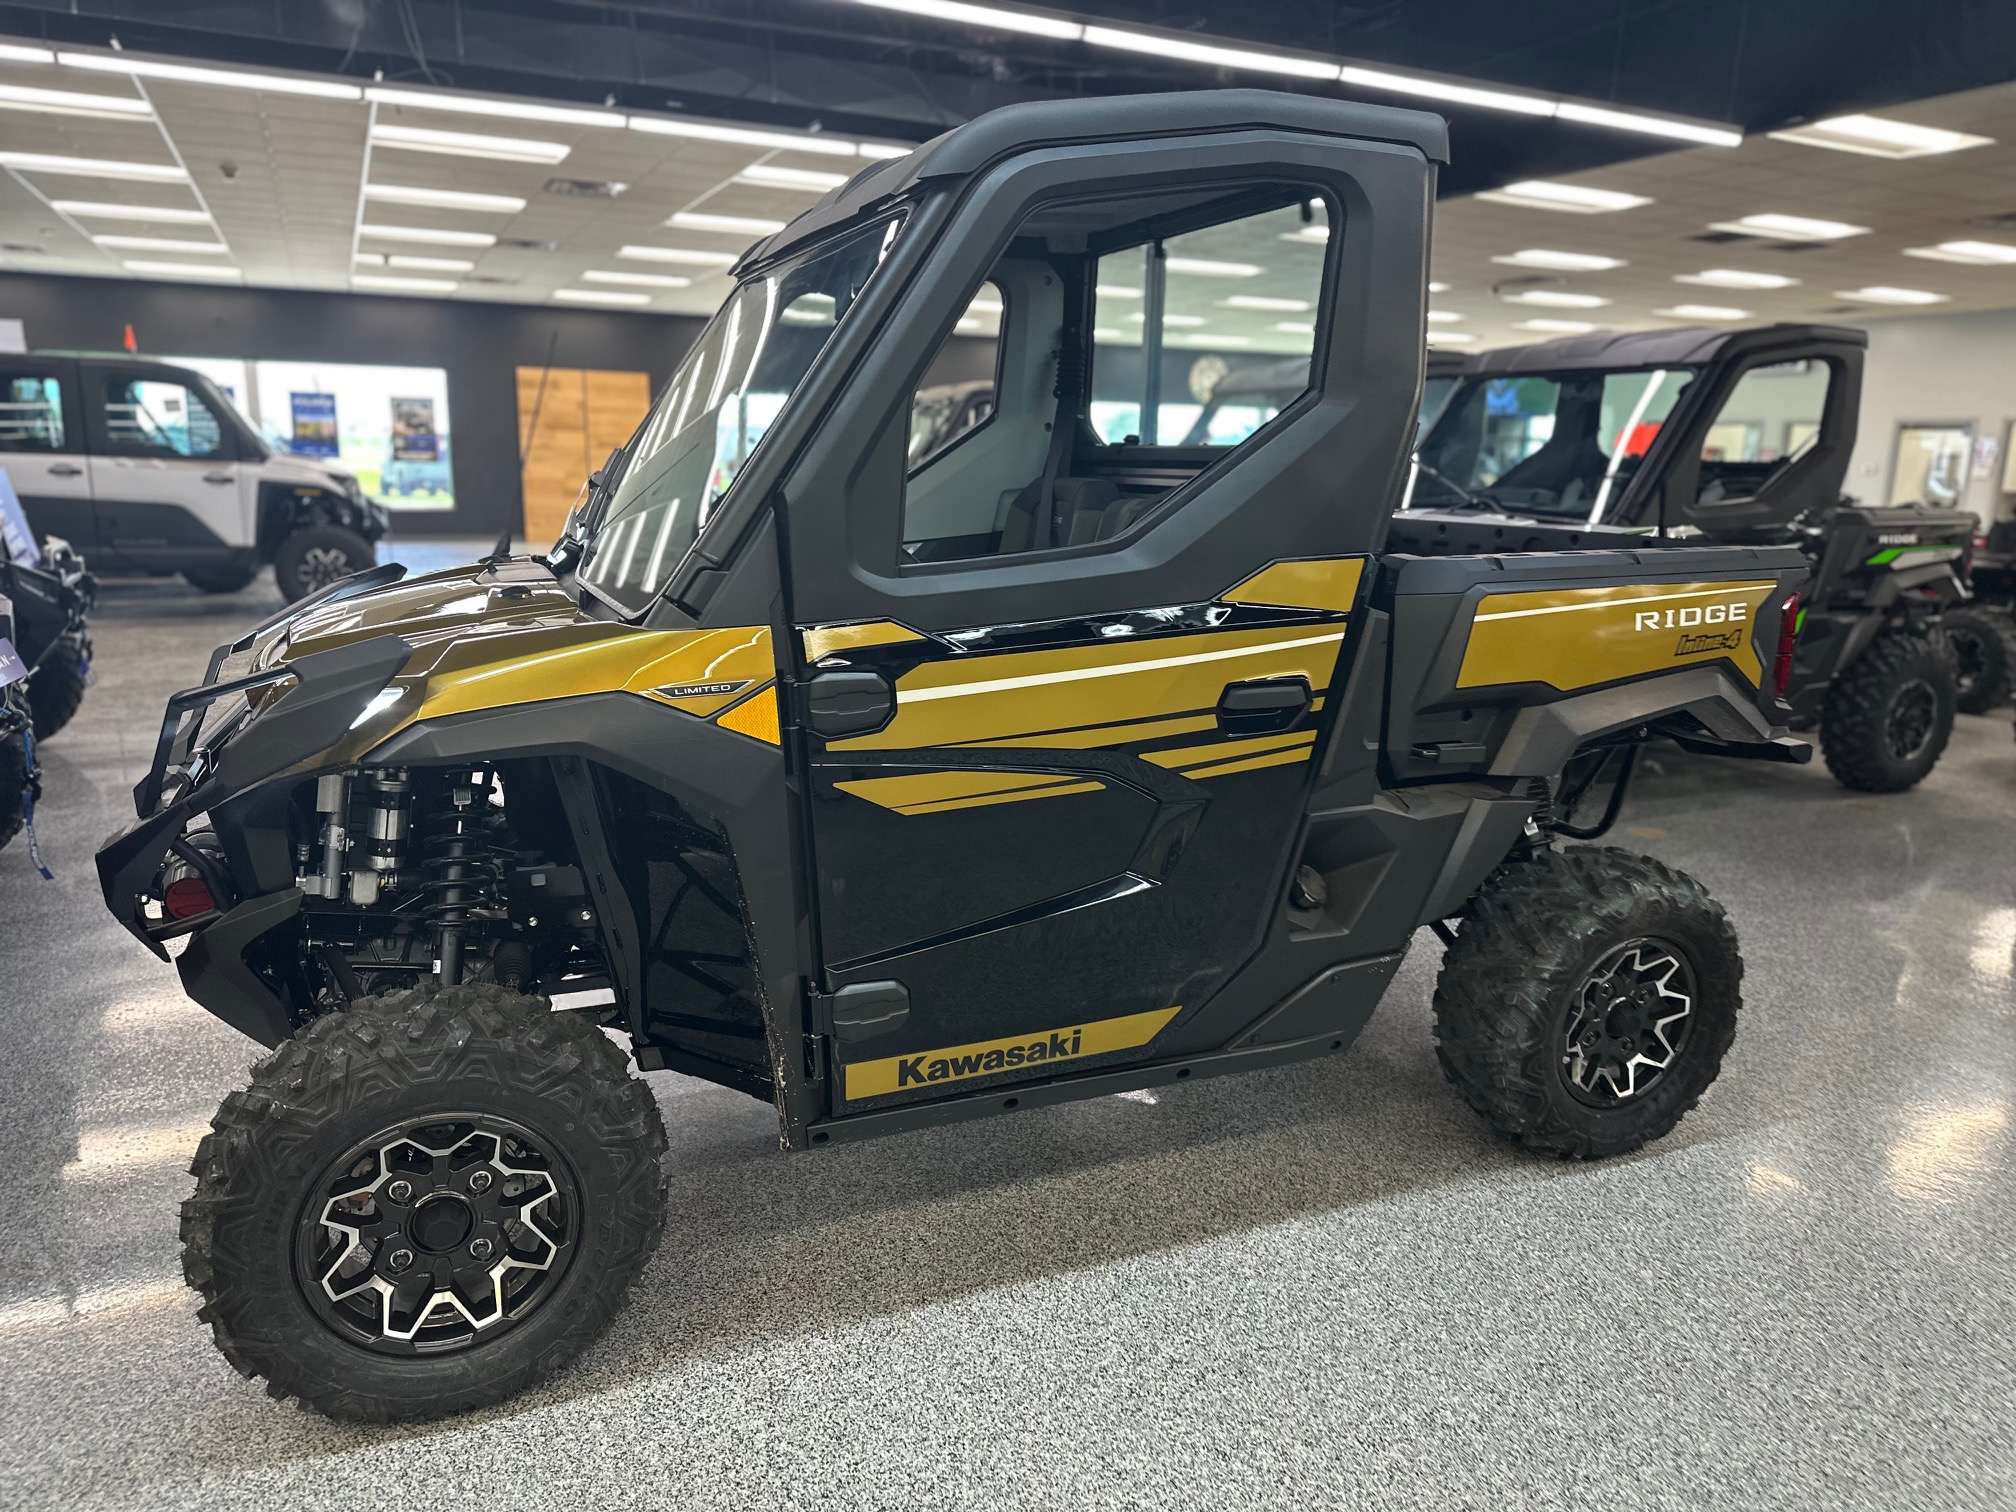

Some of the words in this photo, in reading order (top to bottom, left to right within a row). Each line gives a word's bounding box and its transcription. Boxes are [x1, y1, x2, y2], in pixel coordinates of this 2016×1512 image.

[1634, 602, 1748, 632] RIDGE
[674, 684, 731, 695] LIMITED
[898, 1029, 1082, 1087] Kawasaki
